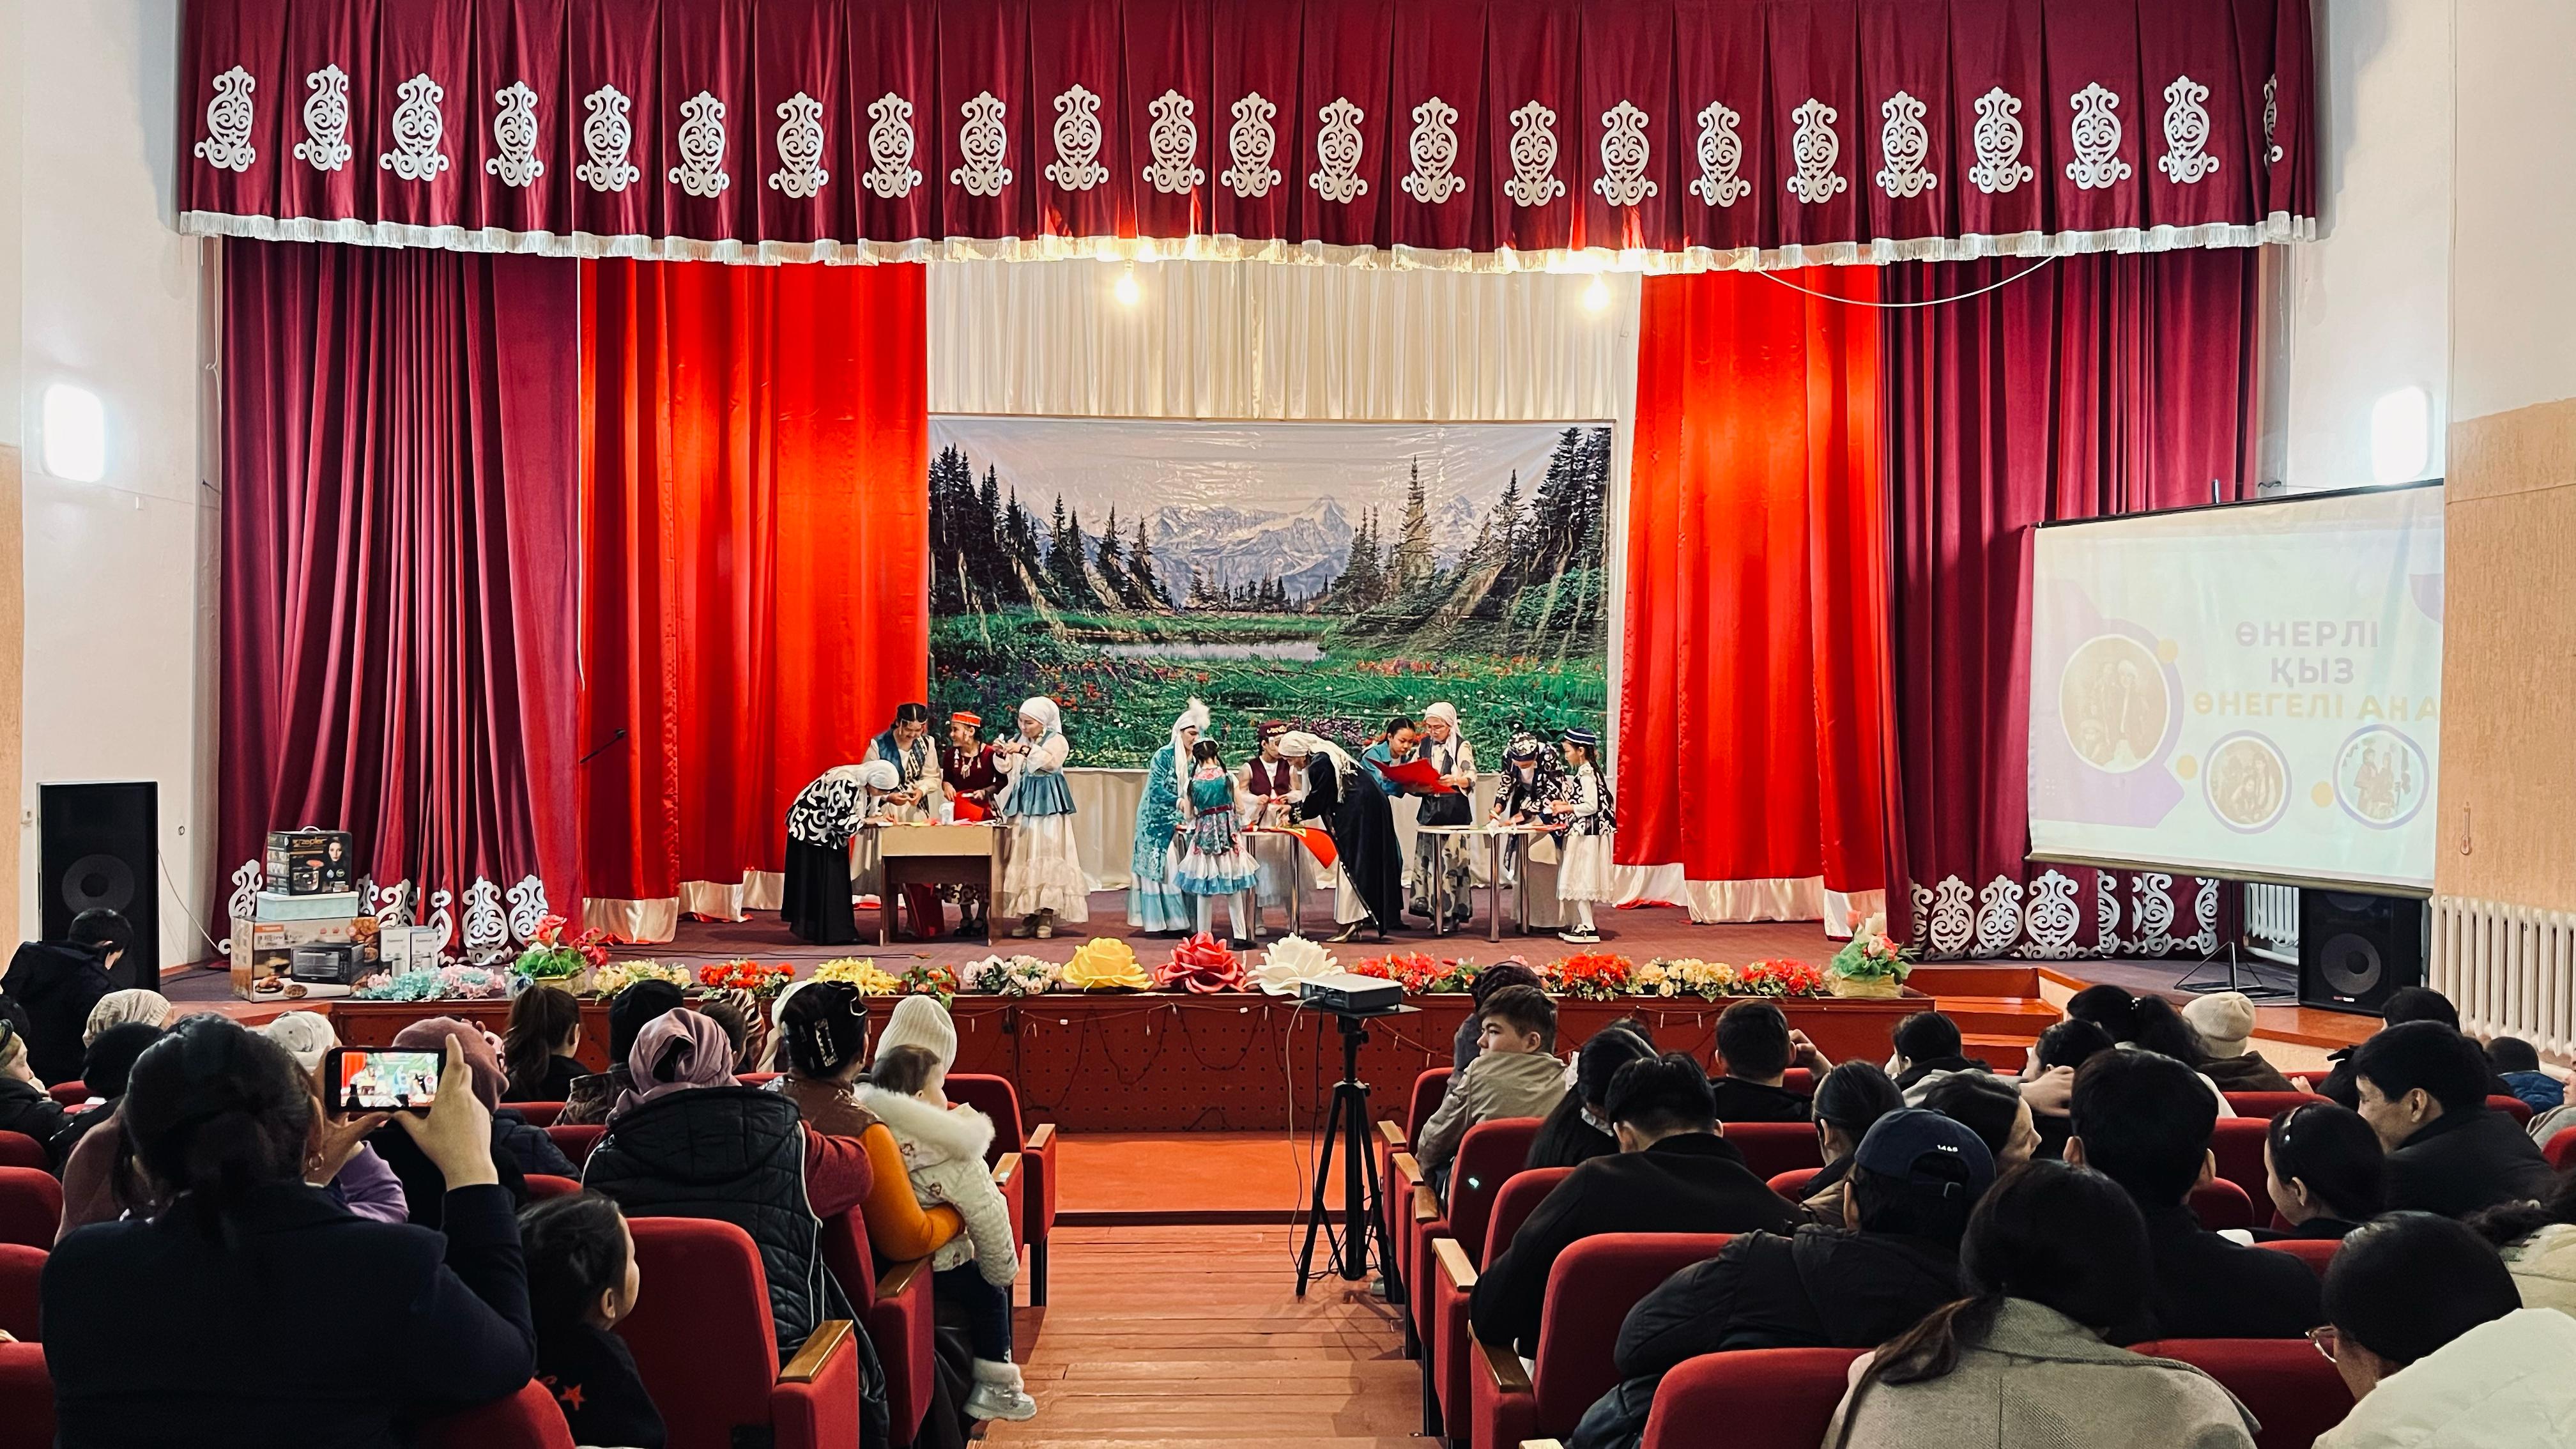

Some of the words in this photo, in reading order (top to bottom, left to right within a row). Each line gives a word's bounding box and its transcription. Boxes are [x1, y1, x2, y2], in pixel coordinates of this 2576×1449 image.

[2235, 620, 2379, 648] ӨНЕРЛІ
[2271, 657, 2354, 688] ҚЫЗ
[2193, 691, 2343, 718] ӨНЕГЕЛІ
[2357, 694, 2439, 721] АНА
